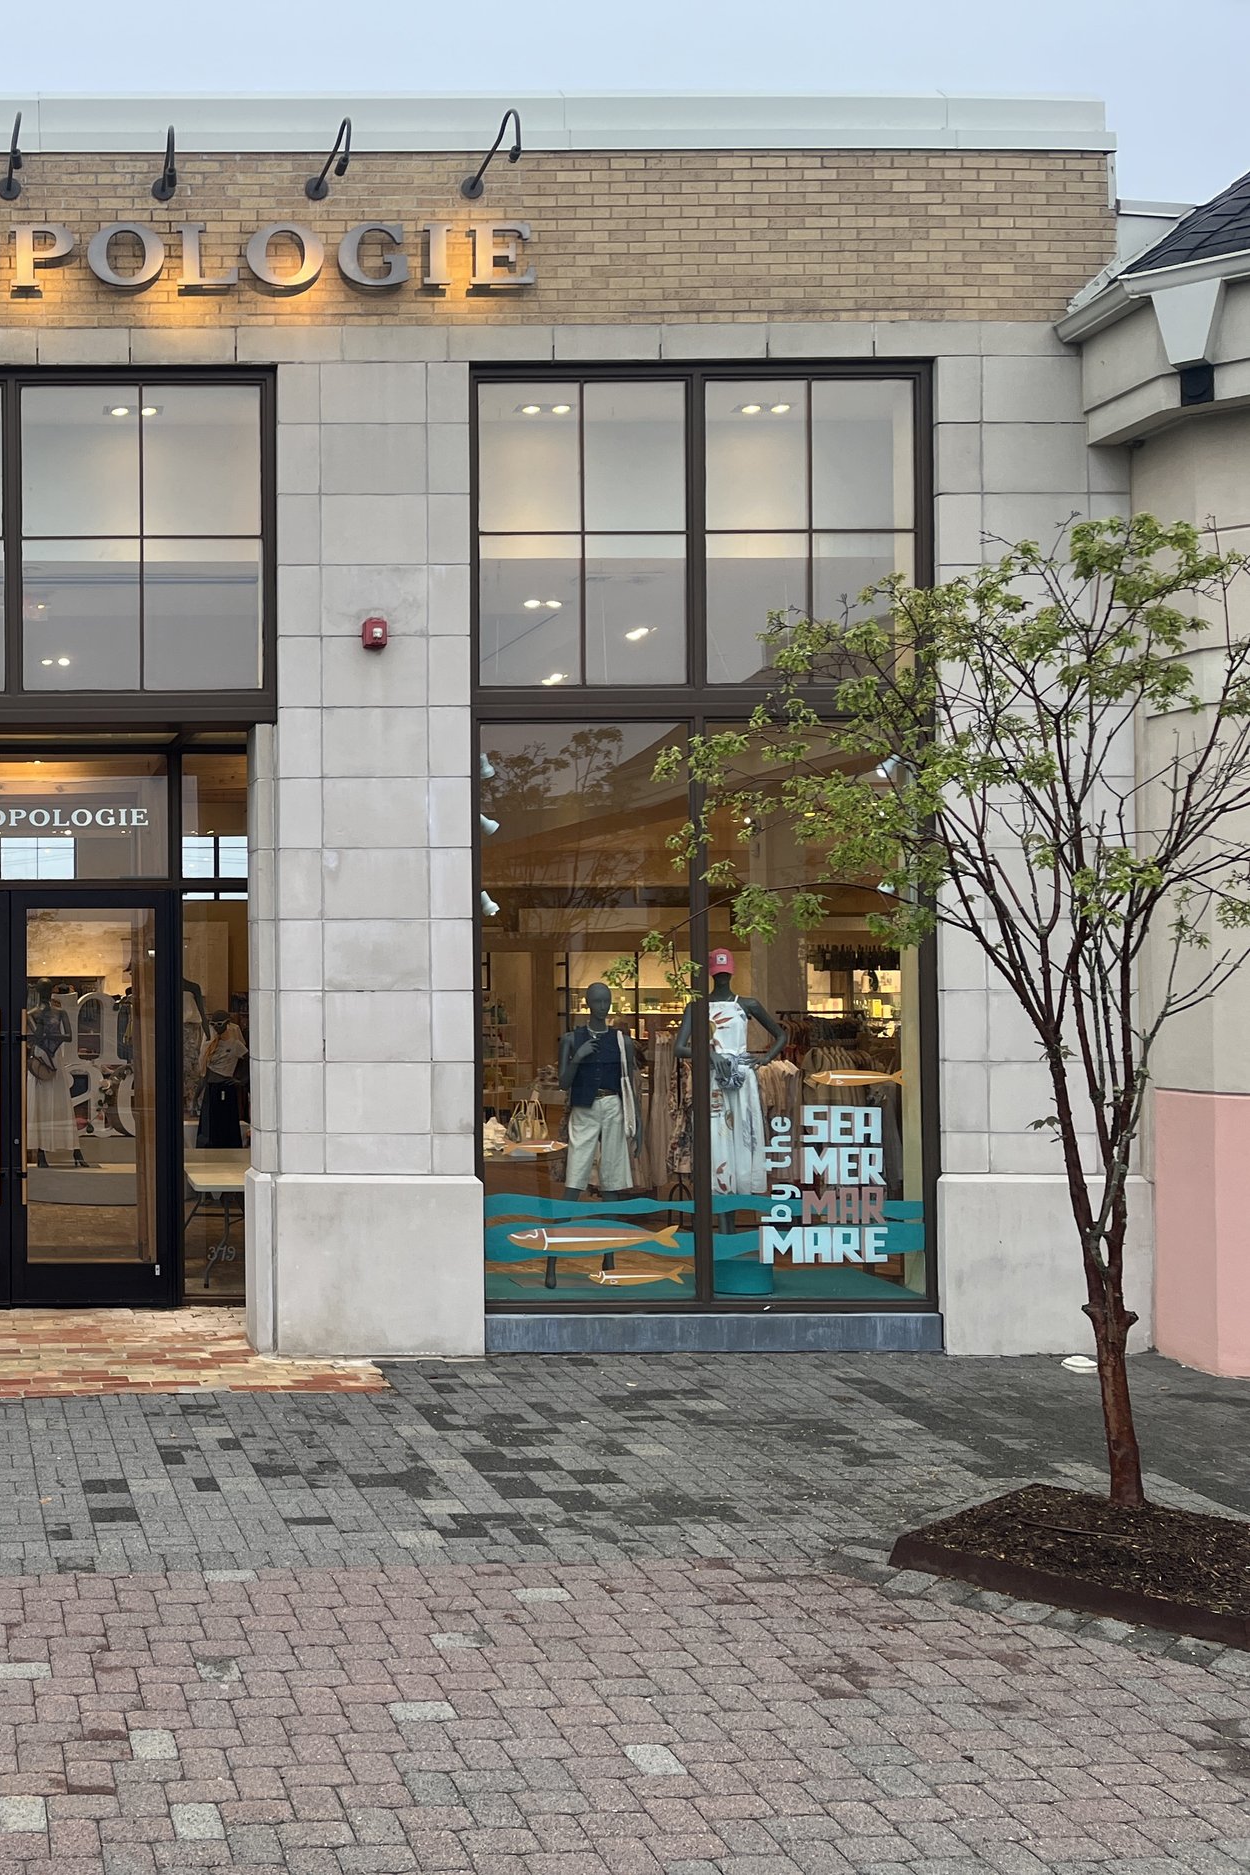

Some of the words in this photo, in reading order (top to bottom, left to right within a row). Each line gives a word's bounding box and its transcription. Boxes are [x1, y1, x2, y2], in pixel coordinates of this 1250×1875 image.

[763, 1116, 792, 1172] the
[801, 1105, 882, 1144] SEA
[801, 1147, 886, 1185] MER
[760, 1183, 801, 1223] by
[802, 1186, 887, 1225] MAR
[759, 1226, 888, 1264] MARE
